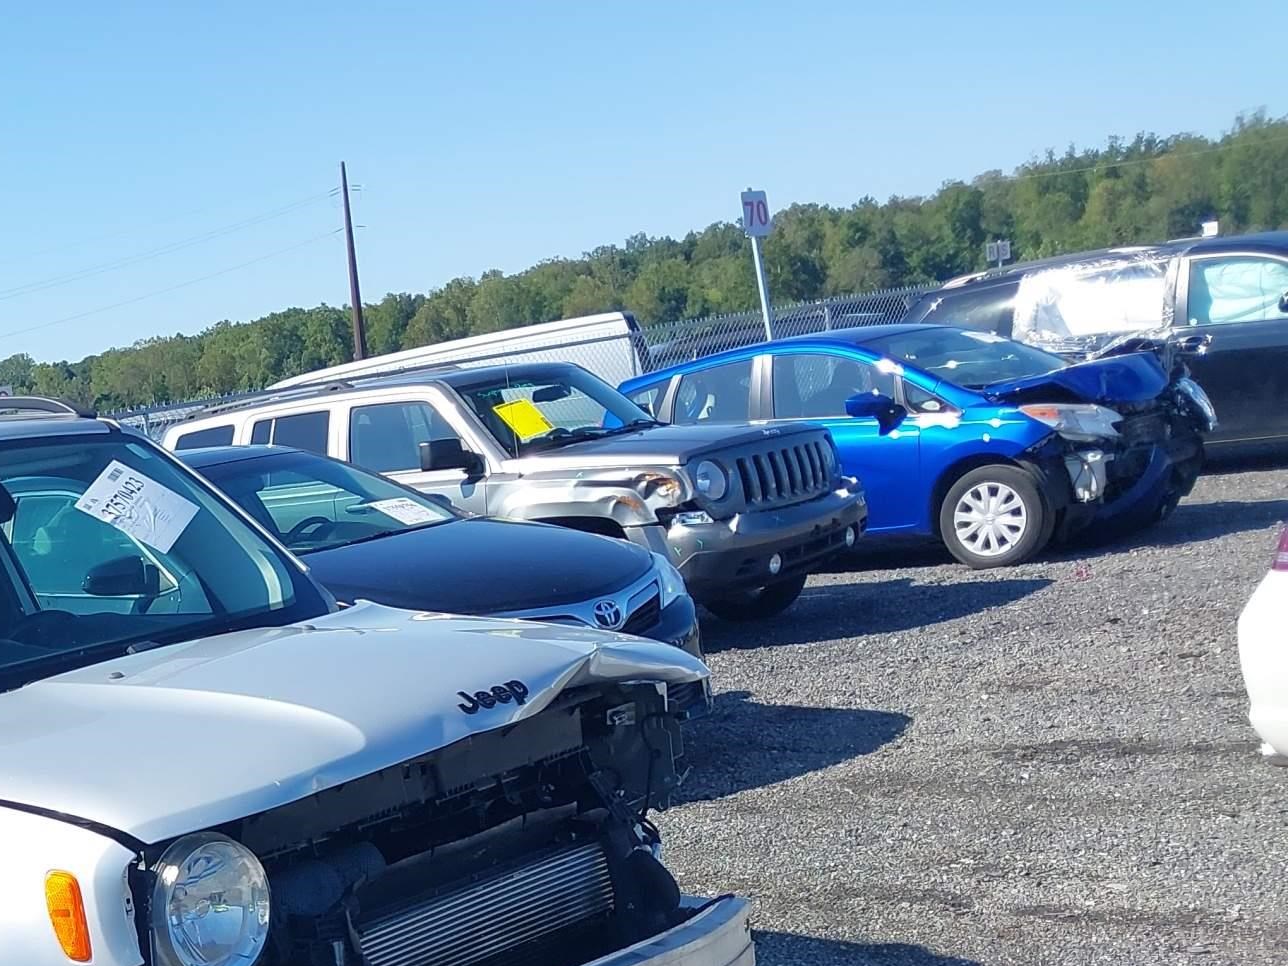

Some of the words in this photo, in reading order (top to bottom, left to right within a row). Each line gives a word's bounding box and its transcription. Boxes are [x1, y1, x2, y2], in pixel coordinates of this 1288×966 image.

[743, 200, 768, 227] 70
[101, 476, 146, 518] 37570423
[456, 679, 529, 715] Jeep
